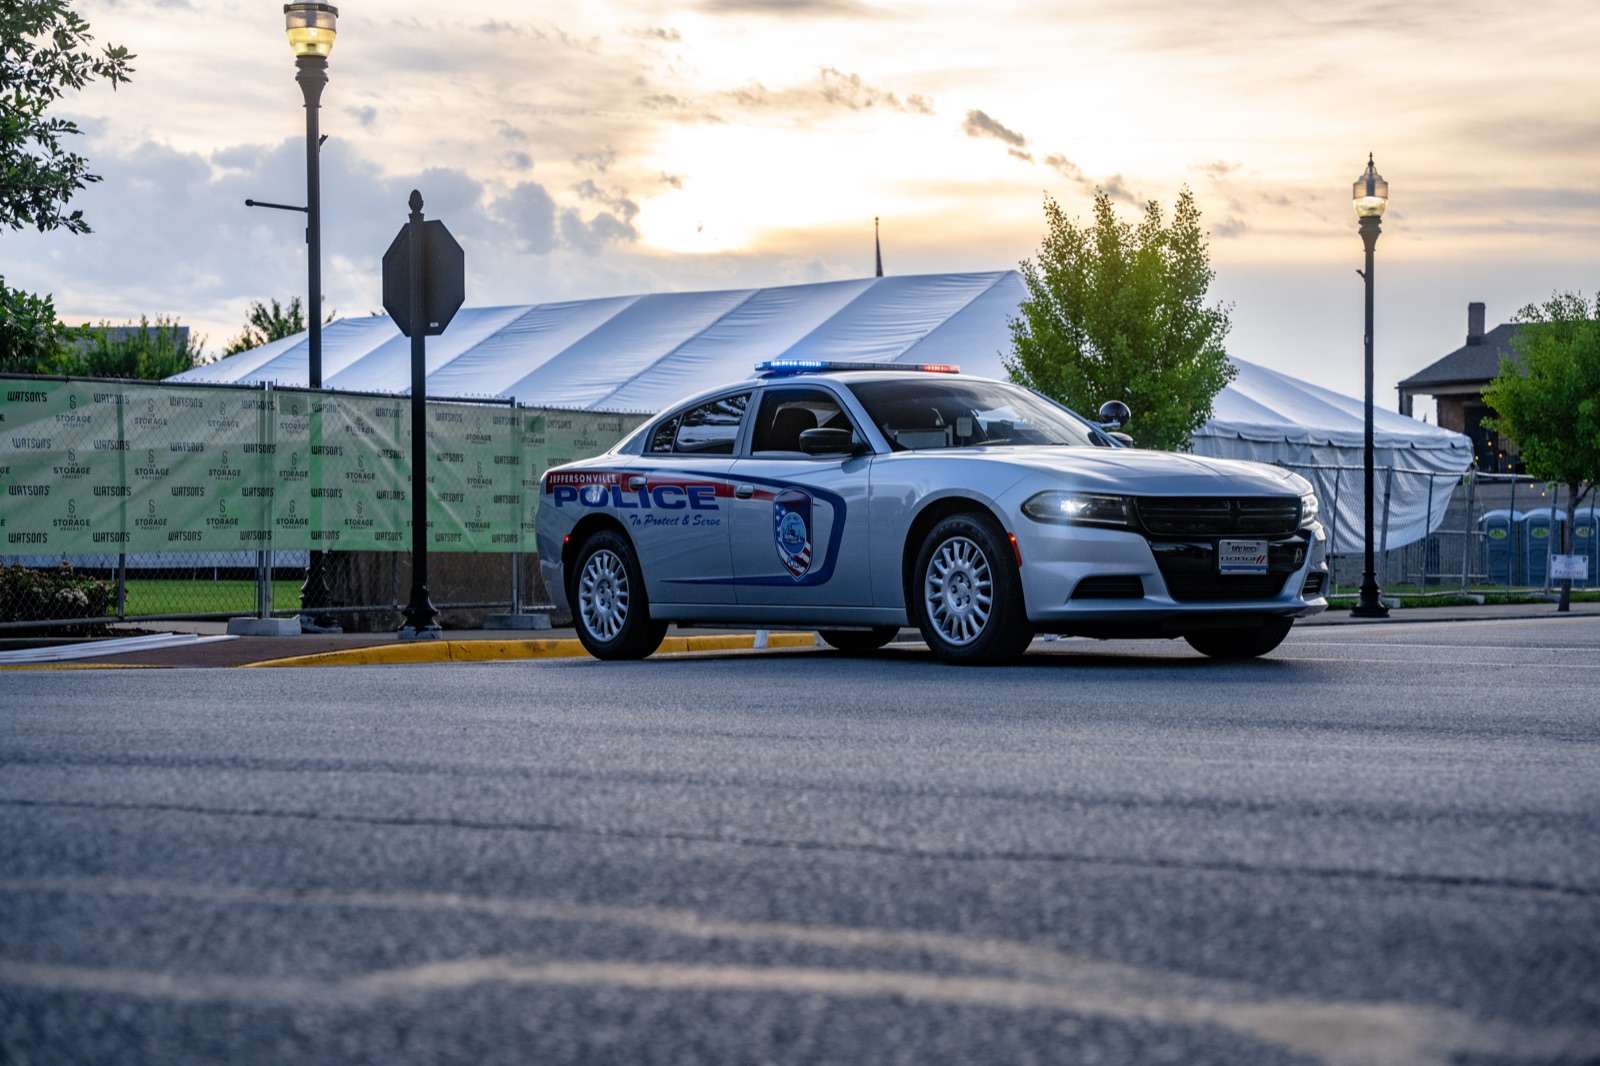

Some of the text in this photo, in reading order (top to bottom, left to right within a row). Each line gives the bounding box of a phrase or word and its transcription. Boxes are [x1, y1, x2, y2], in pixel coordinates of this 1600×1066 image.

[53, 466, 91, 475] STORAGE
[134, 468, 169, 477] STORAGE
[208, 469, 240, 478] STORAGE
[345, 472, 375, 481] STORAGE
[550, 473, 618, 483] JEFFERSONVILLE
[553, 484, 720, 510] POLICE
[53, 518, 91, 527] STORAGE
[135, 518, 168, 527] STORAGE
[206, 518, 239, 527] STORAGE
[276, 518, 310, 526] STORAGE
[629, 513, 721, 528] To Protect & Serve
